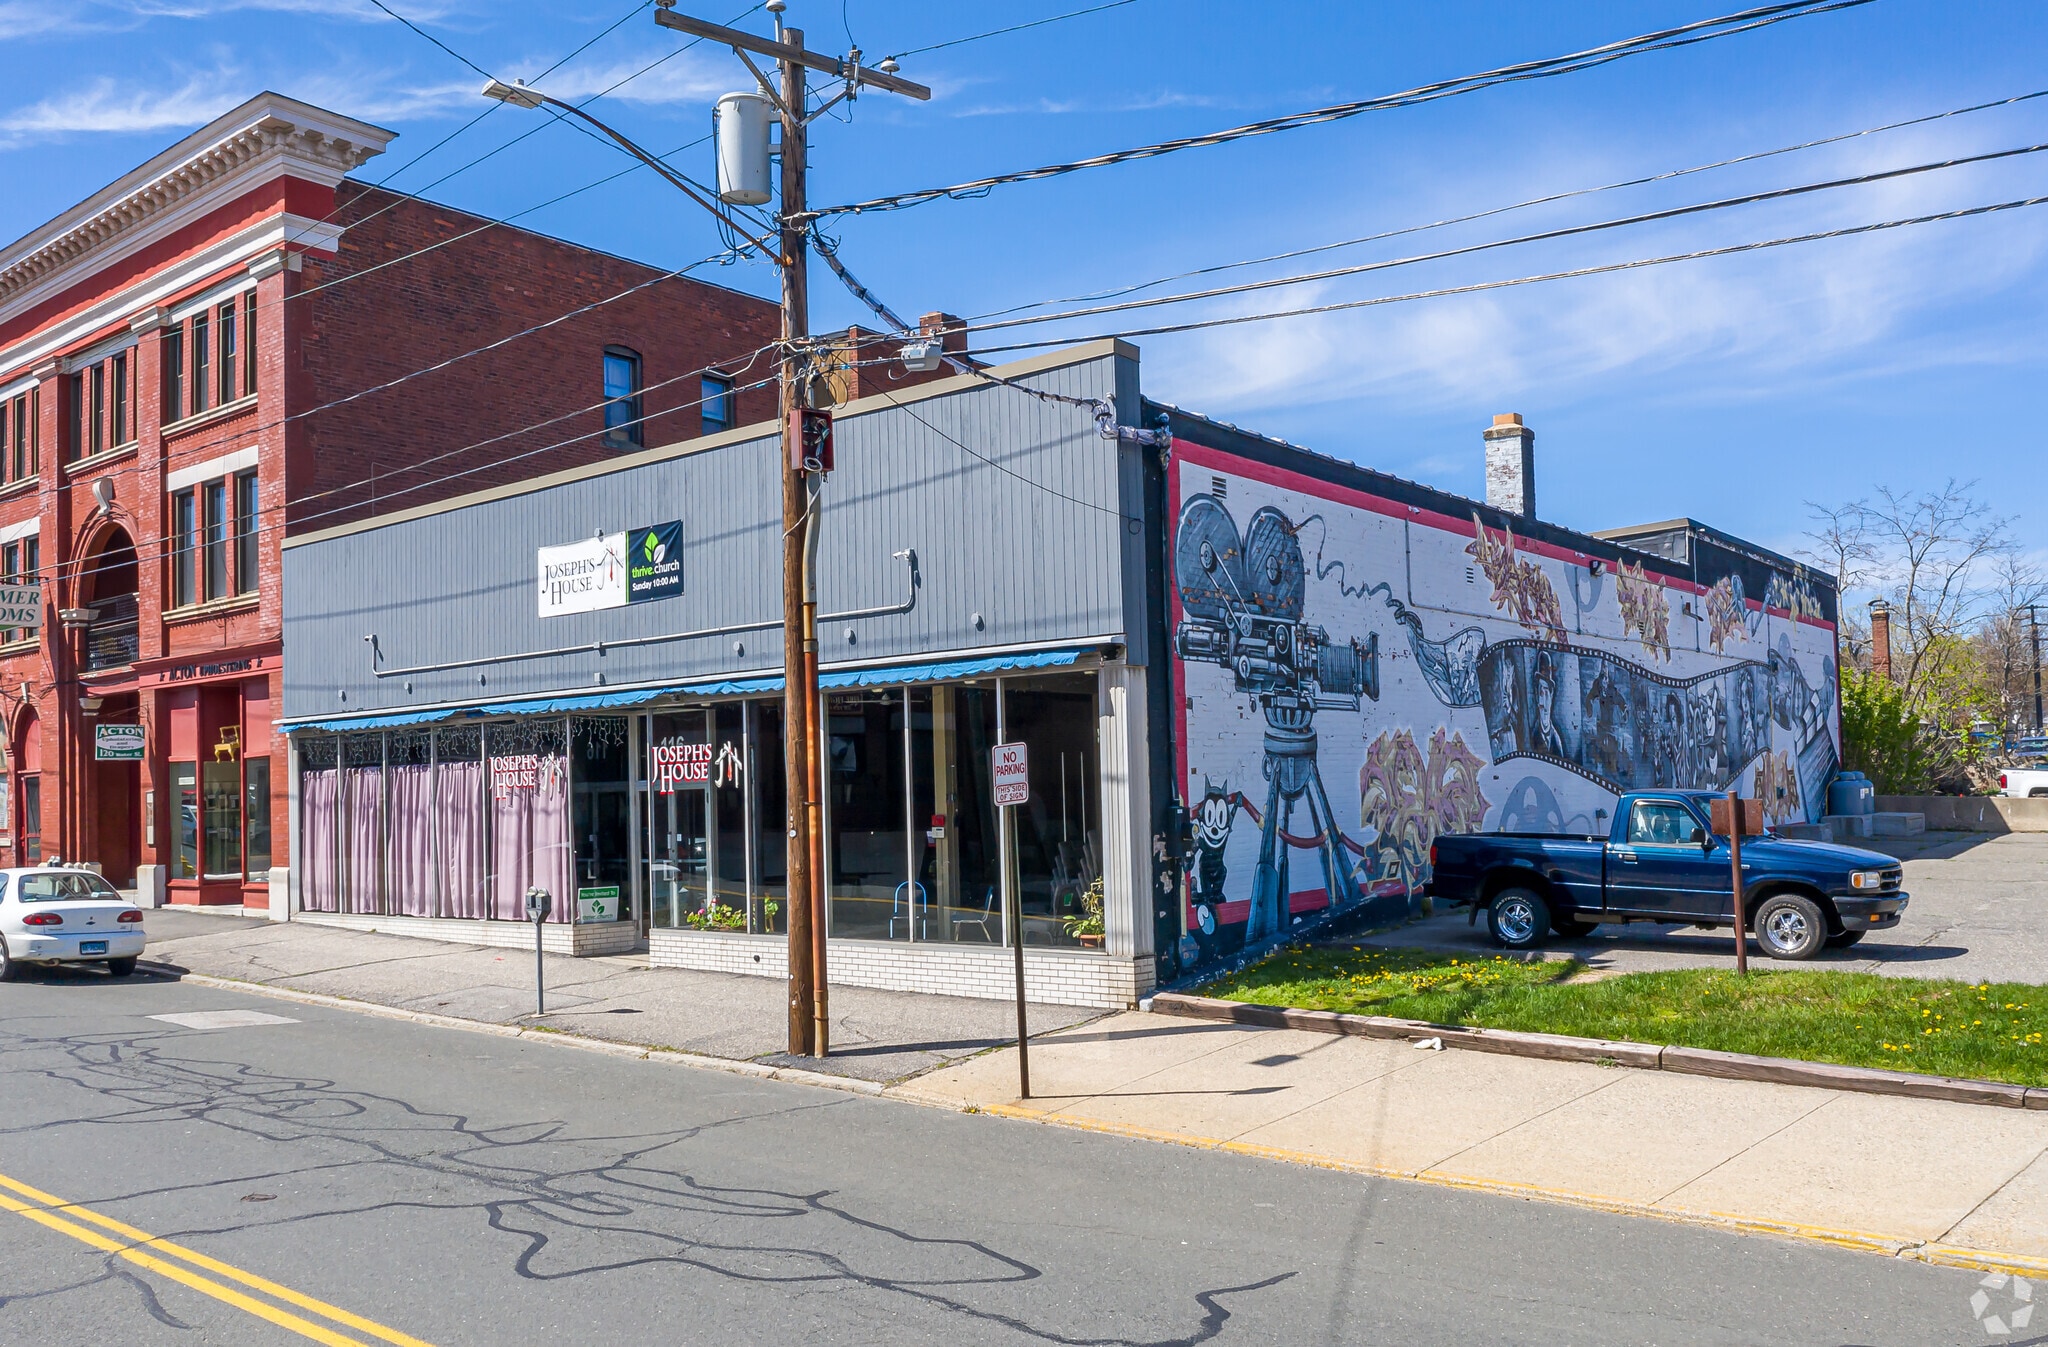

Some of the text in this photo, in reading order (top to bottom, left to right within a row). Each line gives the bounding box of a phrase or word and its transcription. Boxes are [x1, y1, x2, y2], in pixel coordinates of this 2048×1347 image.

[541, 558, 595, 594] JOSEPH'S
[631, 560, 680, 579] thrive.church
[550, 577, 592, 605] HOUSE
[632, 575, 679, 592] Sunday 10:00 AM
[169, 660, 252, 682] ACTON UPHOLSTERING
[99, 727, 144, 737] ACTON
[100, 749, 114, 757] 120
[1003, 752, 1017, 763] NO
[488, 754, 538, 790] JOSEPH'S
[651, 743, 713, 785] JOSEPH'S
[996, 763, 1025, 776] PARKING
[495, 771, 535, 801] HOUSE
[659, 762, 709, 795] HOUSE
[1010, 792, 1024, 800] SIGN
